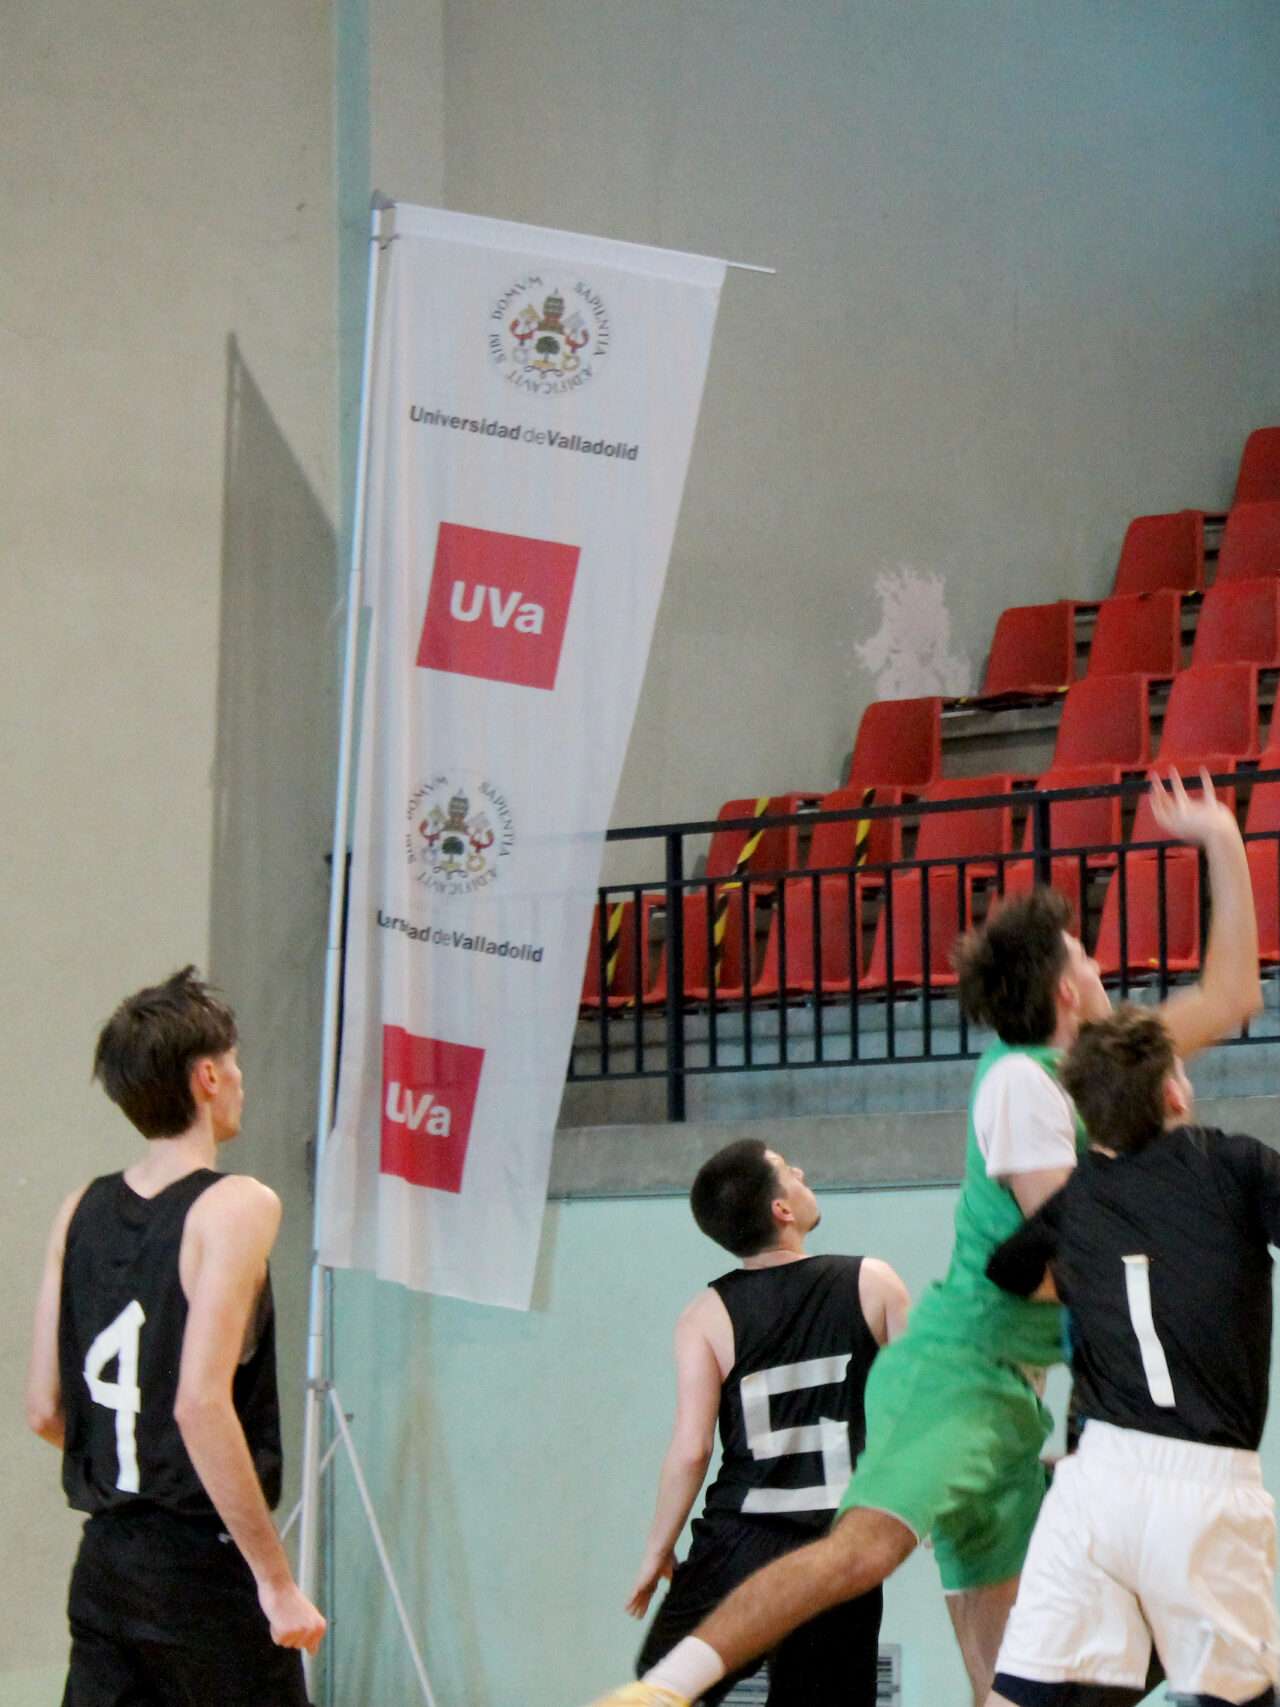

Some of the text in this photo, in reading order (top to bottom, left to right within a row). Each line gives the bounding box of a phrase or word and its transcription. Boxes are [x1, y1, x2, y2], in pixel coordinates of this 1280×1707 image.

[409, 405, 640, 460] Universidad de Valladolid
[450, 580, 545, 635] UVa
[452, 931, 545, 962] Valladolid
[1122, 1254, 1176, 1407] 1
[82, 1299, 146, 1493] 4
[740, 1353, 852, 1513] 5
